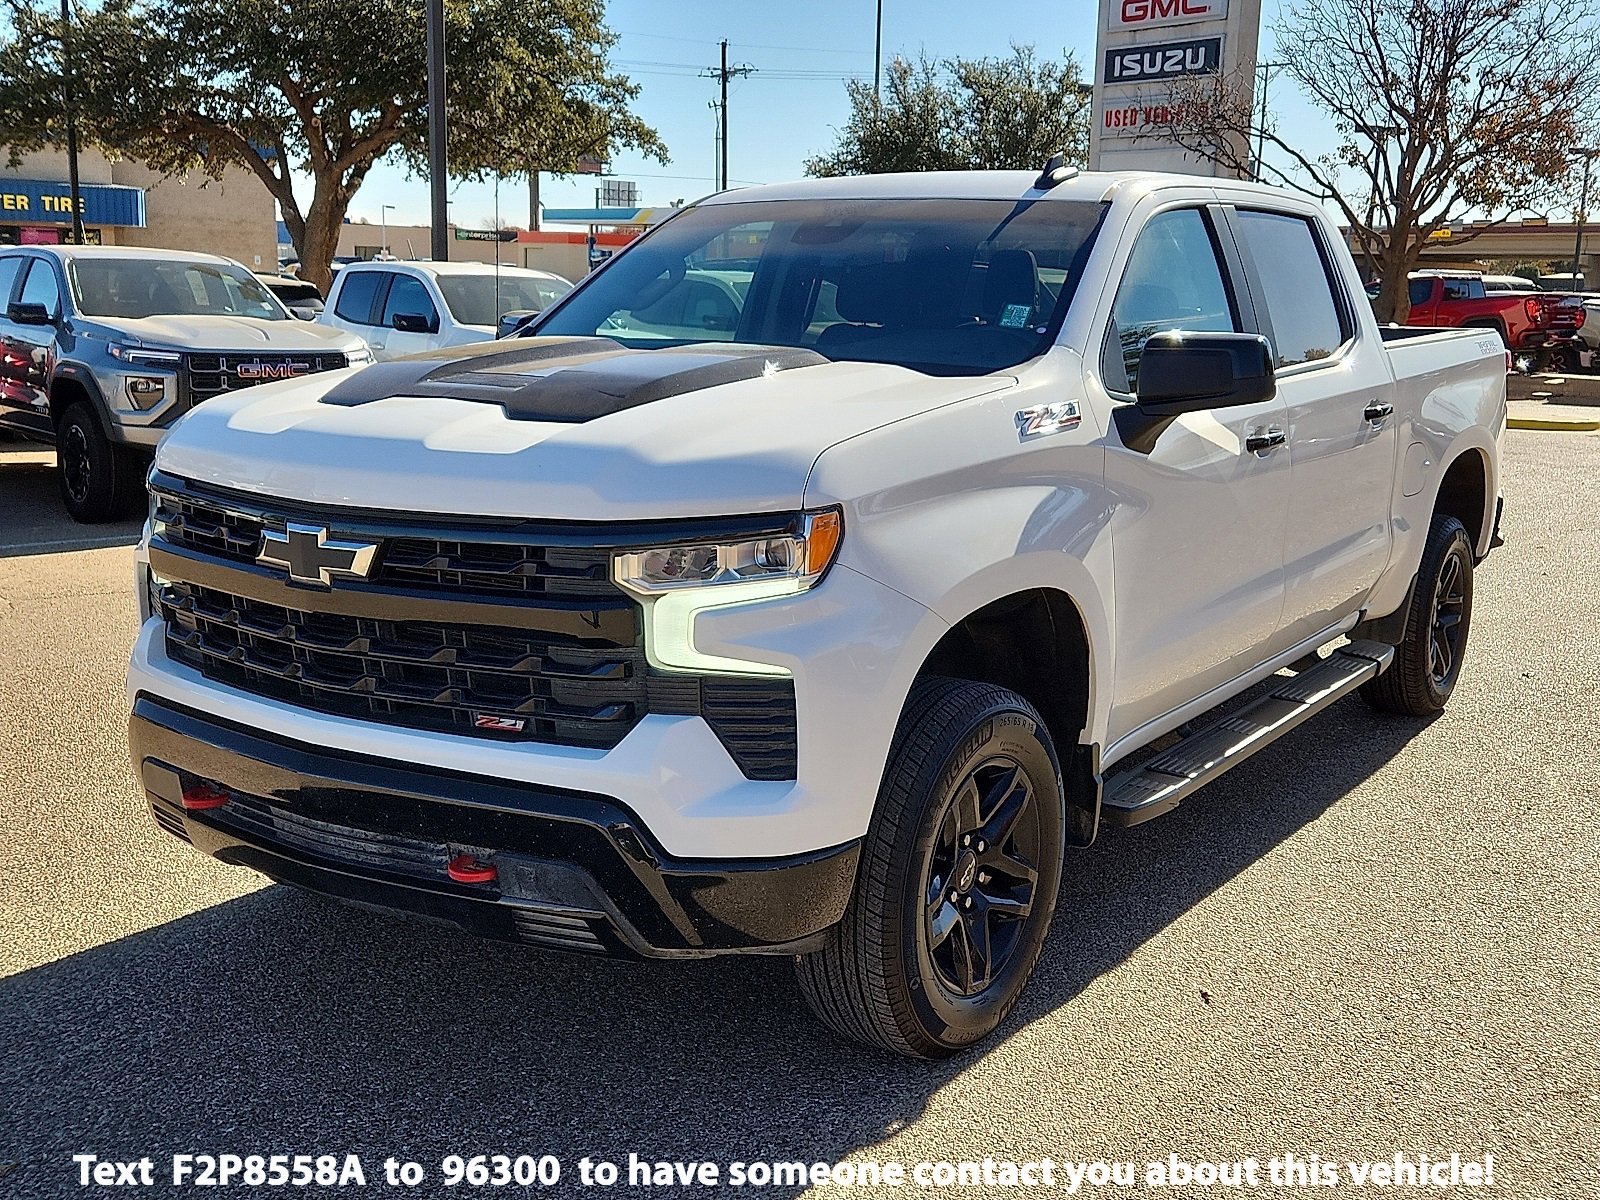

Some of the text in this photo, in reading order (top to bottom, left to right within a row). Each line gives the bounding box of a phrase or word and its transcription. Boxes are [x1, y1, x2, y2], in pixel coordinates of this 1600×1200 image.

[1121, 0, 1208, 23] GMC
[1114, 47, 1206, 77] ISUZU
[1105, 107, 1138, 128] USED
[0, 194, 86, 213] ER TIRE
[237, 363, 310, 378] GMC
[475, 714, 525, 732] Z71
